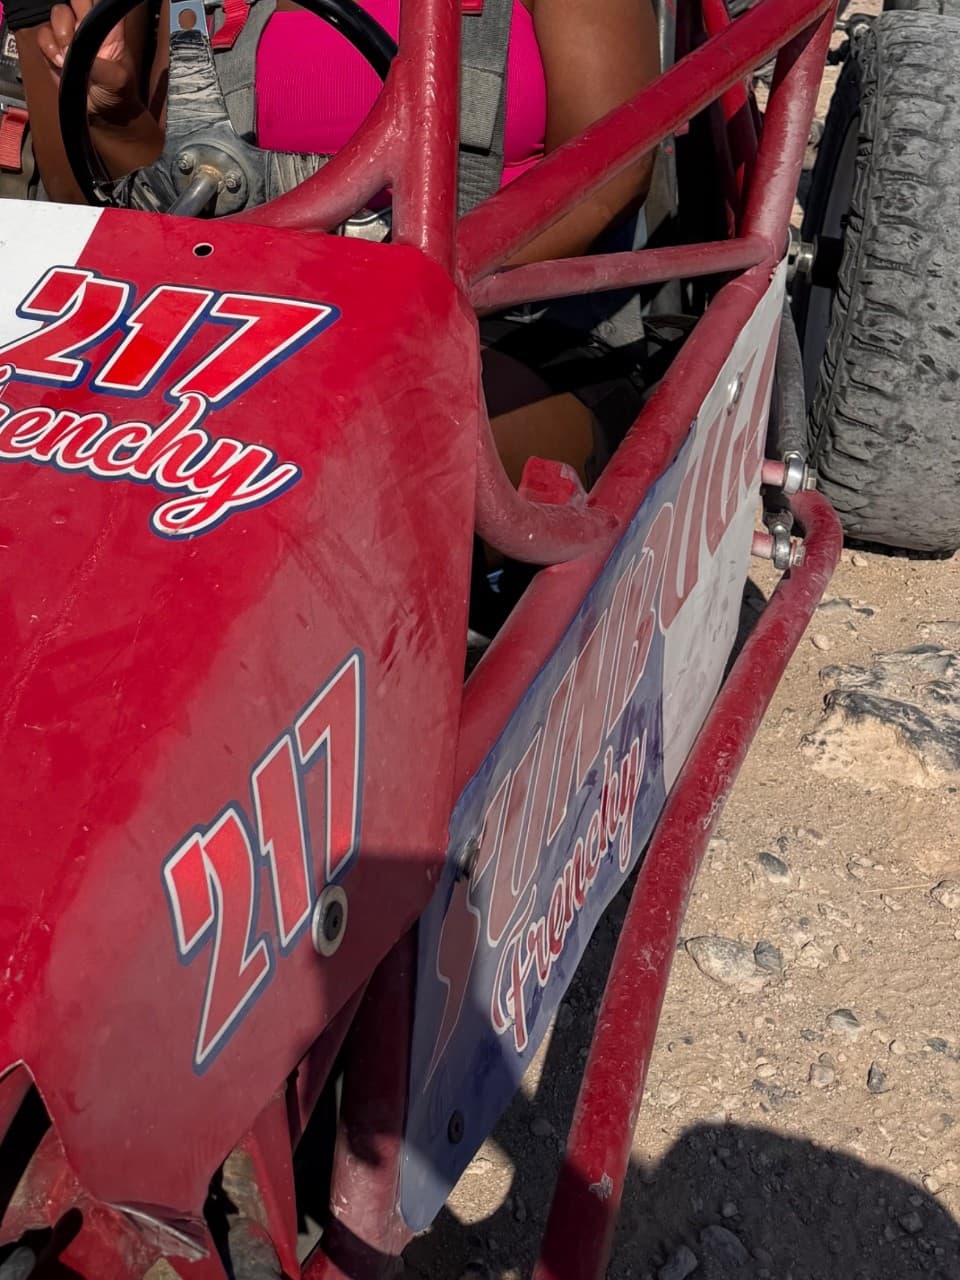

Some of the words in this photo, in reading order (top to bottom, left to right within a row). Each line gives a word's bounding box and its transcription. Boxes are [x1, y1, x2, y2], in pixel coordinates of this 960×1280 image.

[162, 648, 365, 1076] 217
[424, 313, 782, 1094] SUNBUGG
[491, 728, 647, 1052] Frenchy
